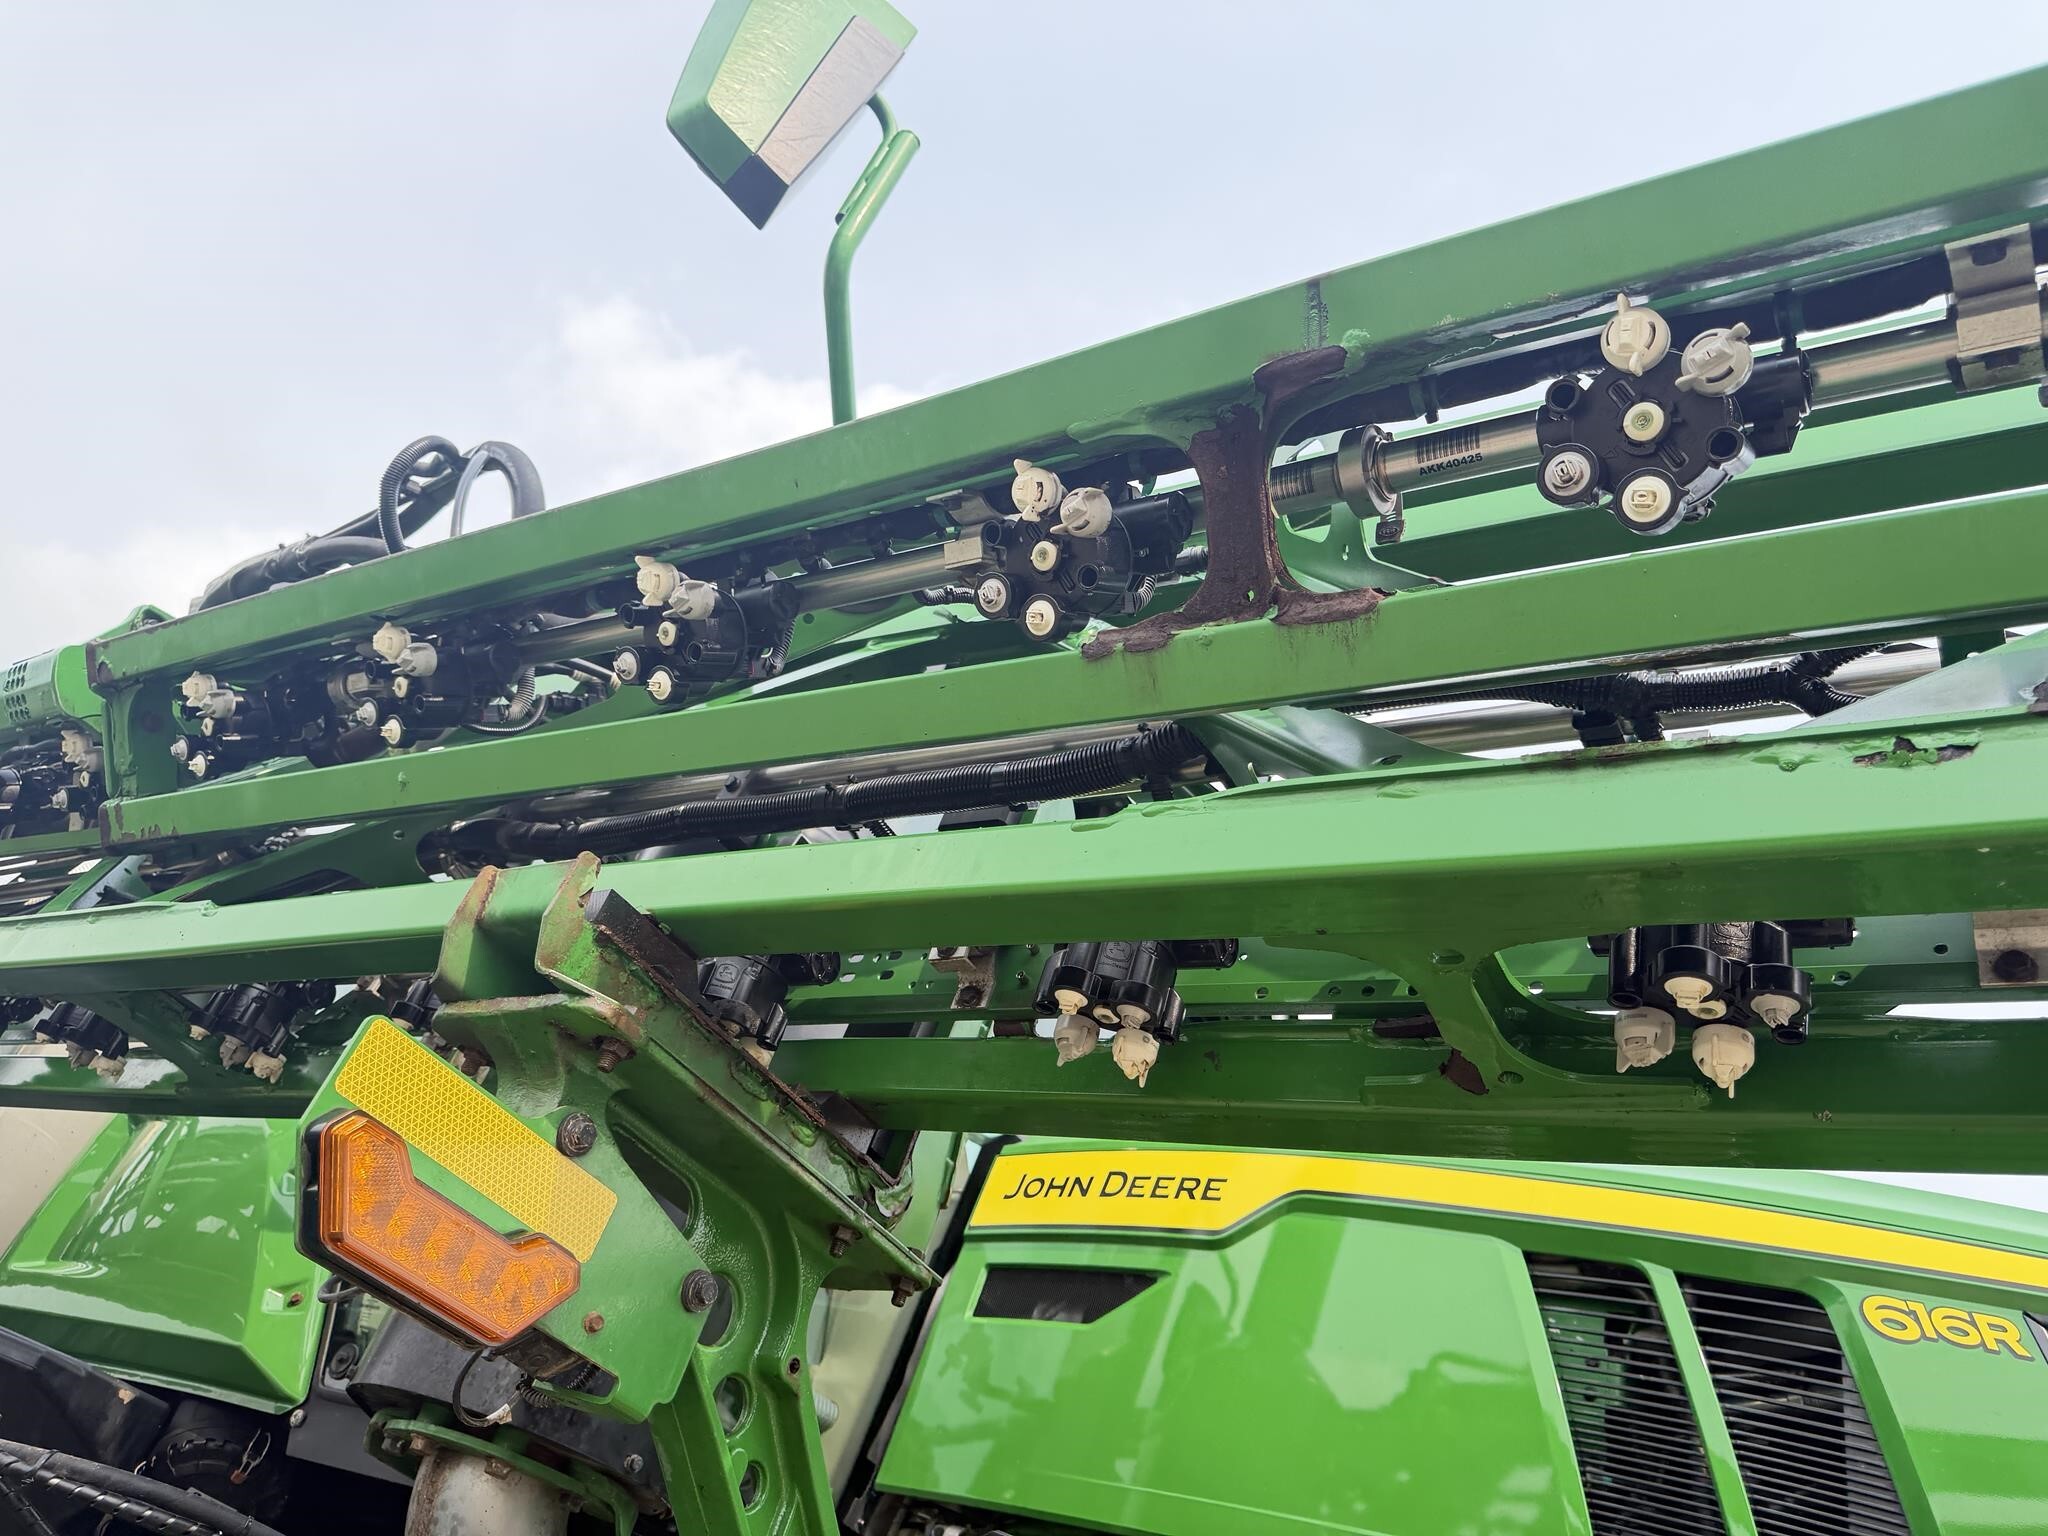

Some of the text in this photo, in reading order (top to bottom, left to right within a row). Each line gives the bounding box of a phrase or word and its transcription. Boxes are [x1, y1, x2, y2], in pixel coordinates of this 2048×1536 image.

[1419, 453, 1483, 476] AKK40425
[1003, 1171, 1228, 1201] JOHN DEERE
[1860, 1294, 2035, 1361] 616R
